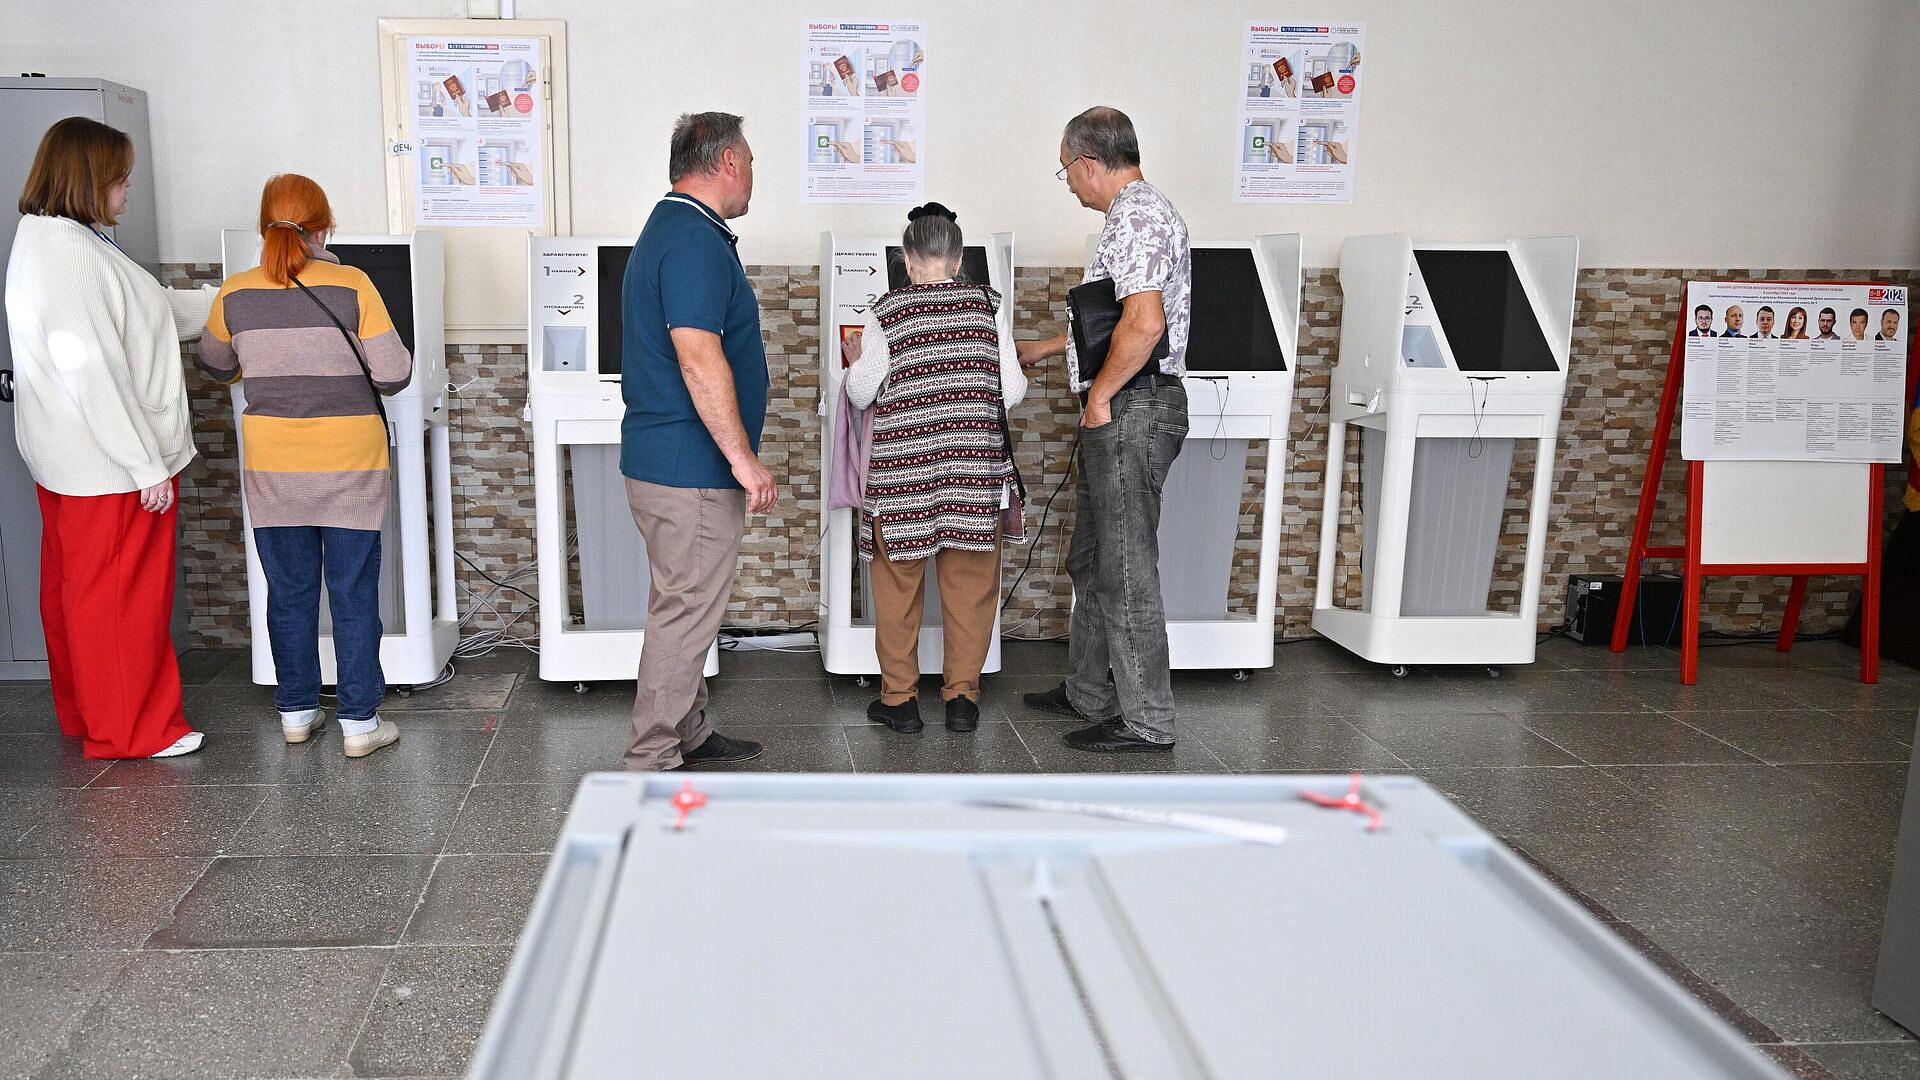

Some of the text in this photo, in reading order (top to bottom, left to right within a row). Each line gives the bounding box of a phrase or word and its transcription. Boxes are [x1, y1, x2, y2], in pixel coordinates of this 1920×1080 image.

[544, 266, 551, 276] 1
[835, 265, 842, 275] 1
[573, 294, 584, 305] 2
[866, 293, 877, 304] 2
[1409, 295, 1422, 305] 2
